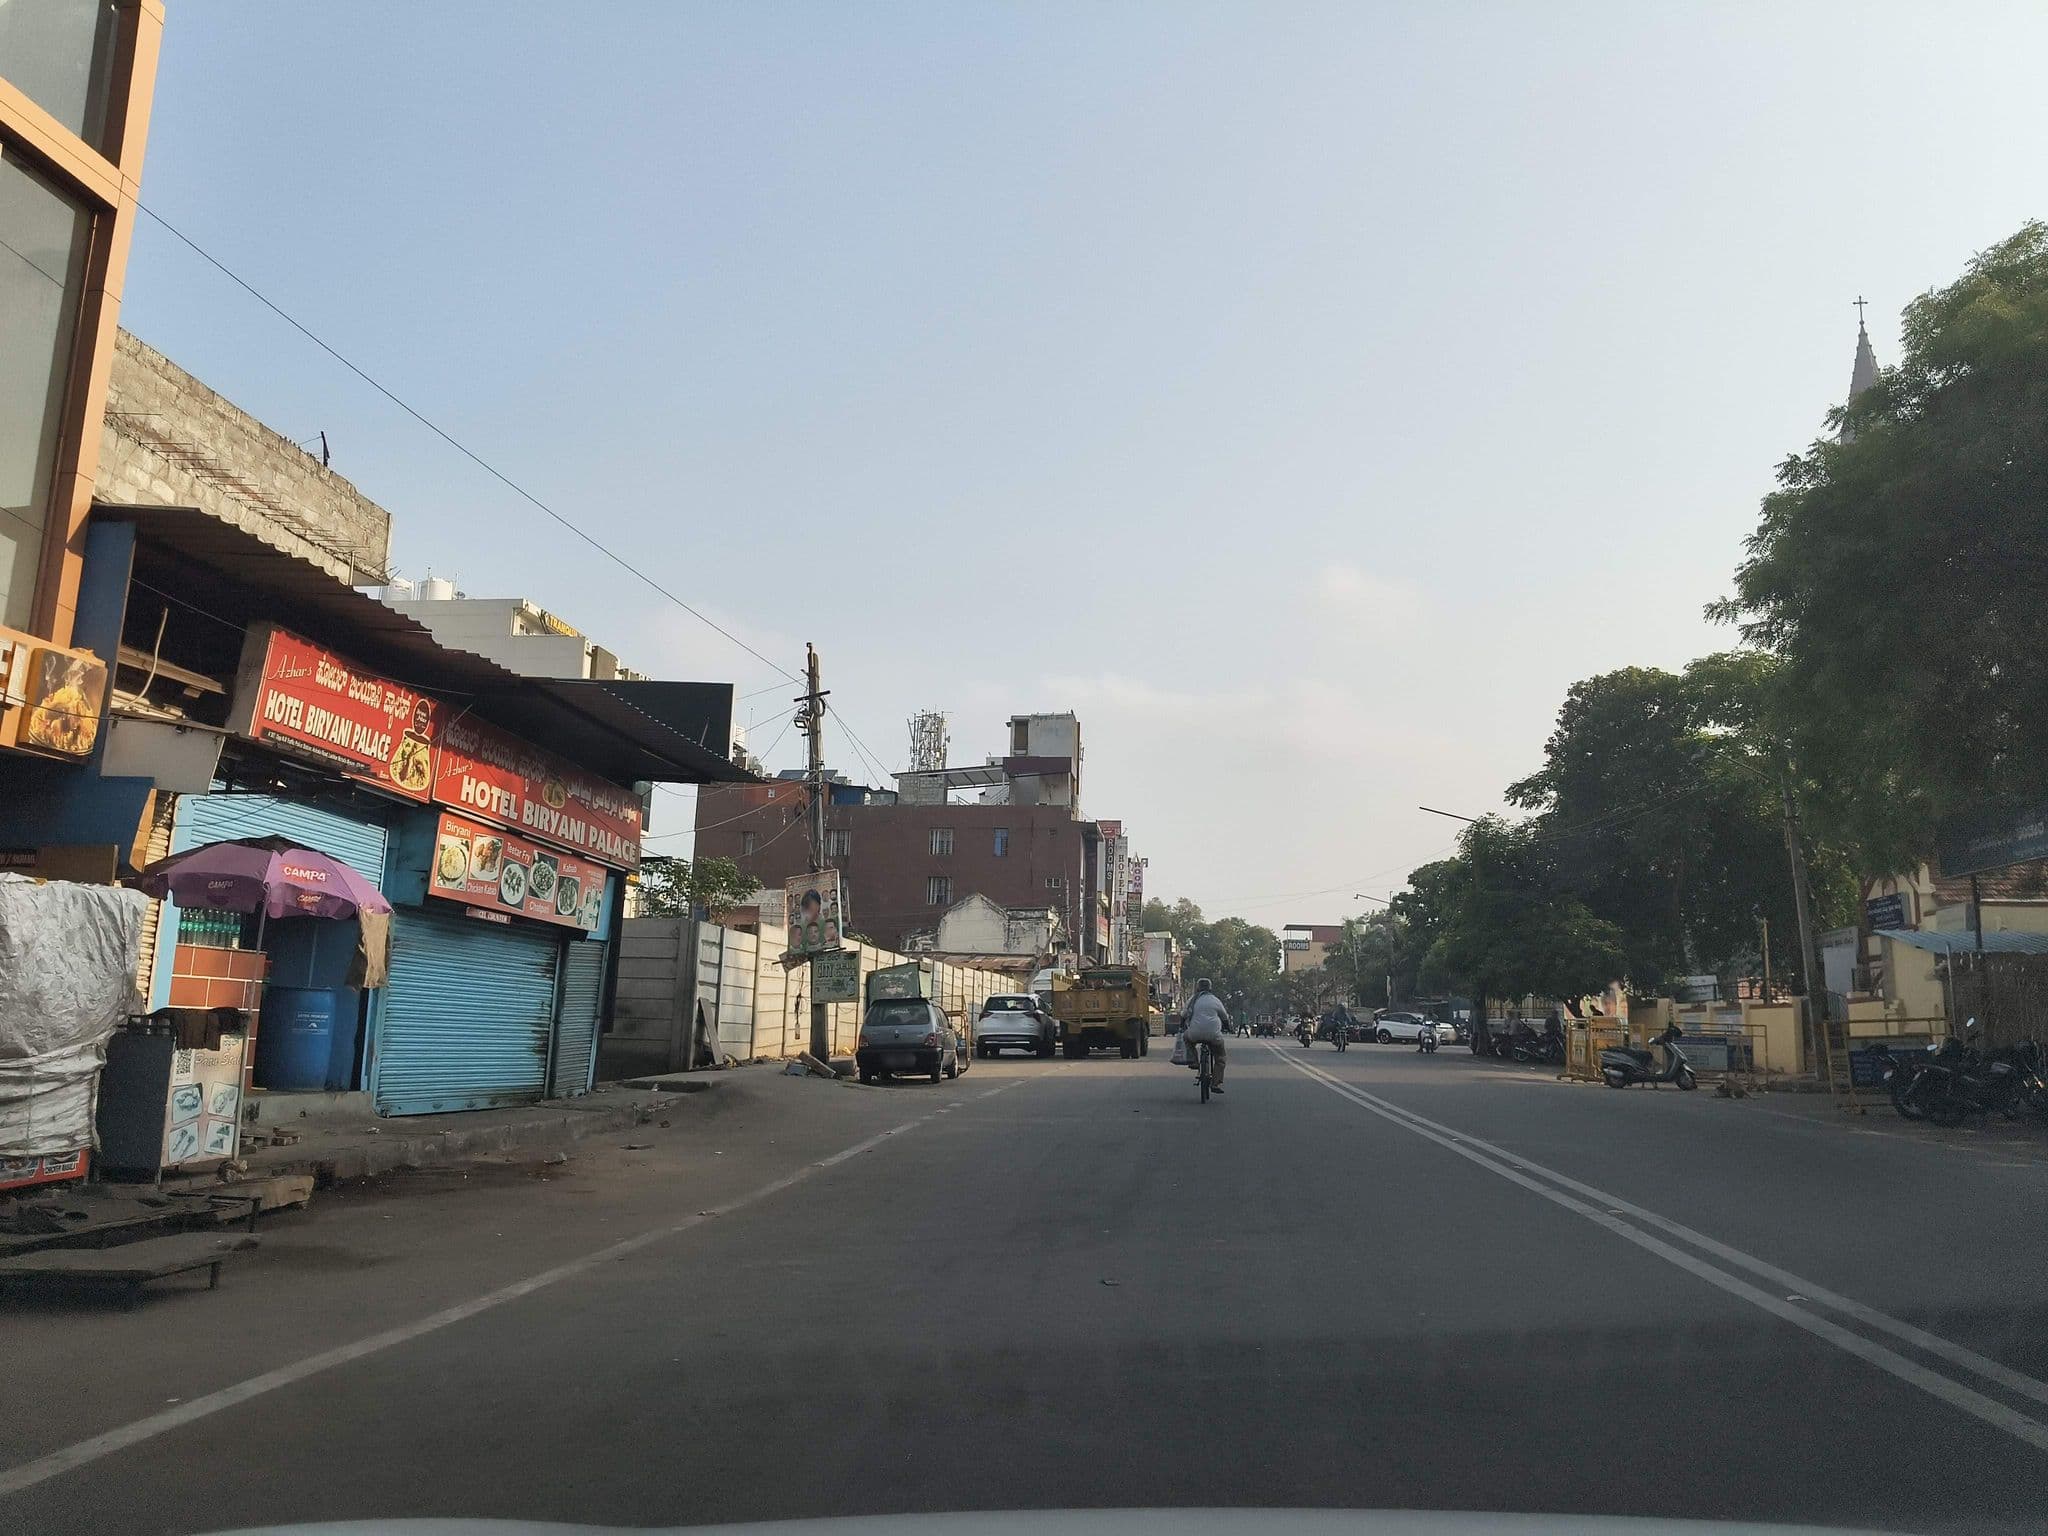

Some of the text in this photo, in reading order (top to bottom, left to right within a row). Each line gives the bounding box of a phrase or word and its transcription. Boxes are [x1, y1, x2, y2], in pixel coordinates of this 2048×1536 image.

[264, 688, 305, 731] HOTEL
[305, 703, 353, 749] BIRYANI
[351, 723, 393, 763] PALACE
[445, 820, 472, 839] Biryani
[460, 774, 638, 863] HOTEL BIRYANI PALACE
[283, 866, 326, 882] CAMPA
[1106, 838, 1114, 880] ROOMS
[1288, 942, 1309, 950] ROOMS
